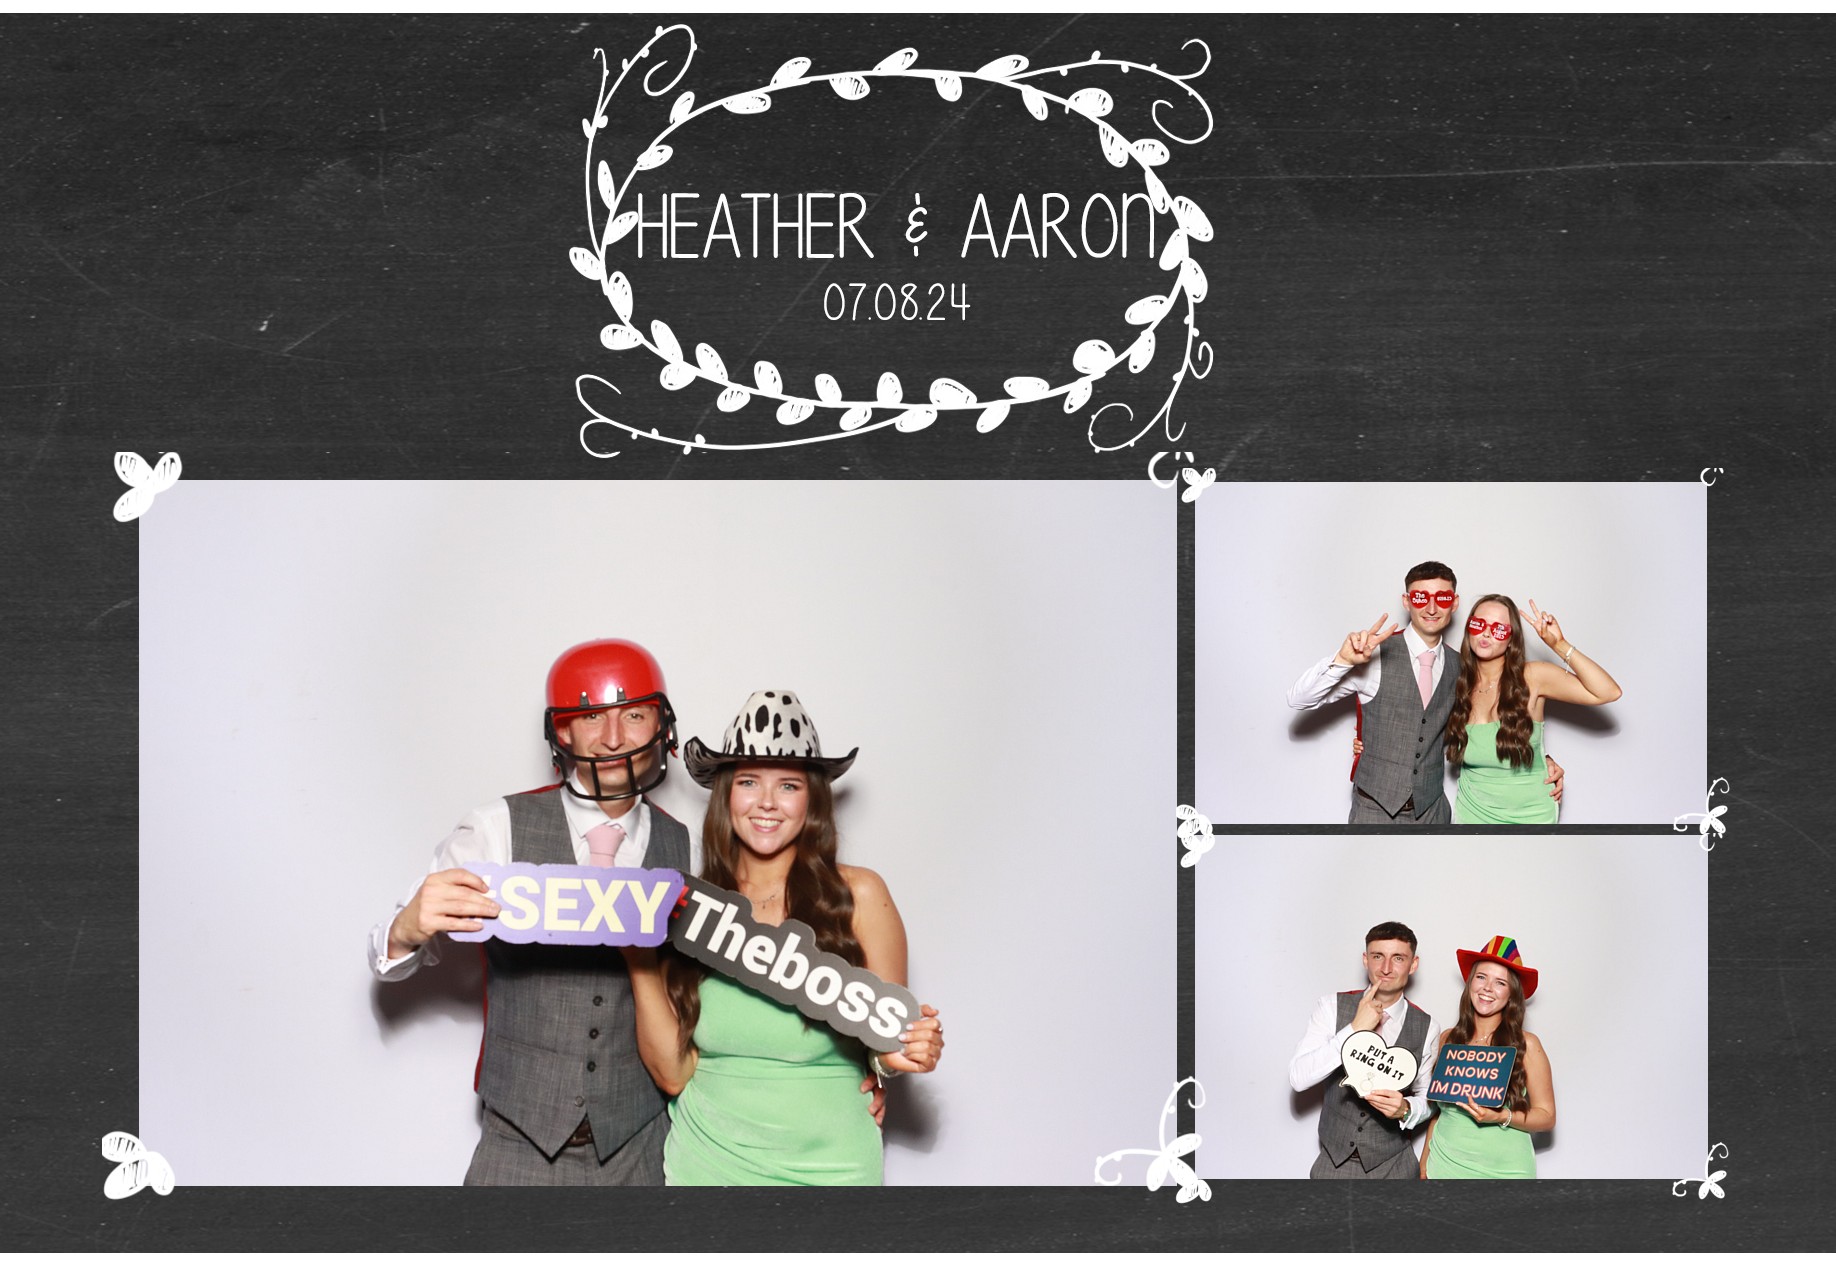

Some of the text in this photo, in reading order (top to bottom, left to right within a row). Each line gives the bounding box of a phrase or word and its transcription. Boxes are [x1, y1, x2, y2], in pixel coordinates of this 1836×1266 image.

[1367, 1045, 1394, 1064] PUT A
[1446, 1049, 1507, 1063] NOBODY
[1350, 1049, 1404, 1080] RING ON IT
[1444, 1065, 1499, 1080] KNOWS
[1430, 1080, 1505, 1100] I'M DRUNK
